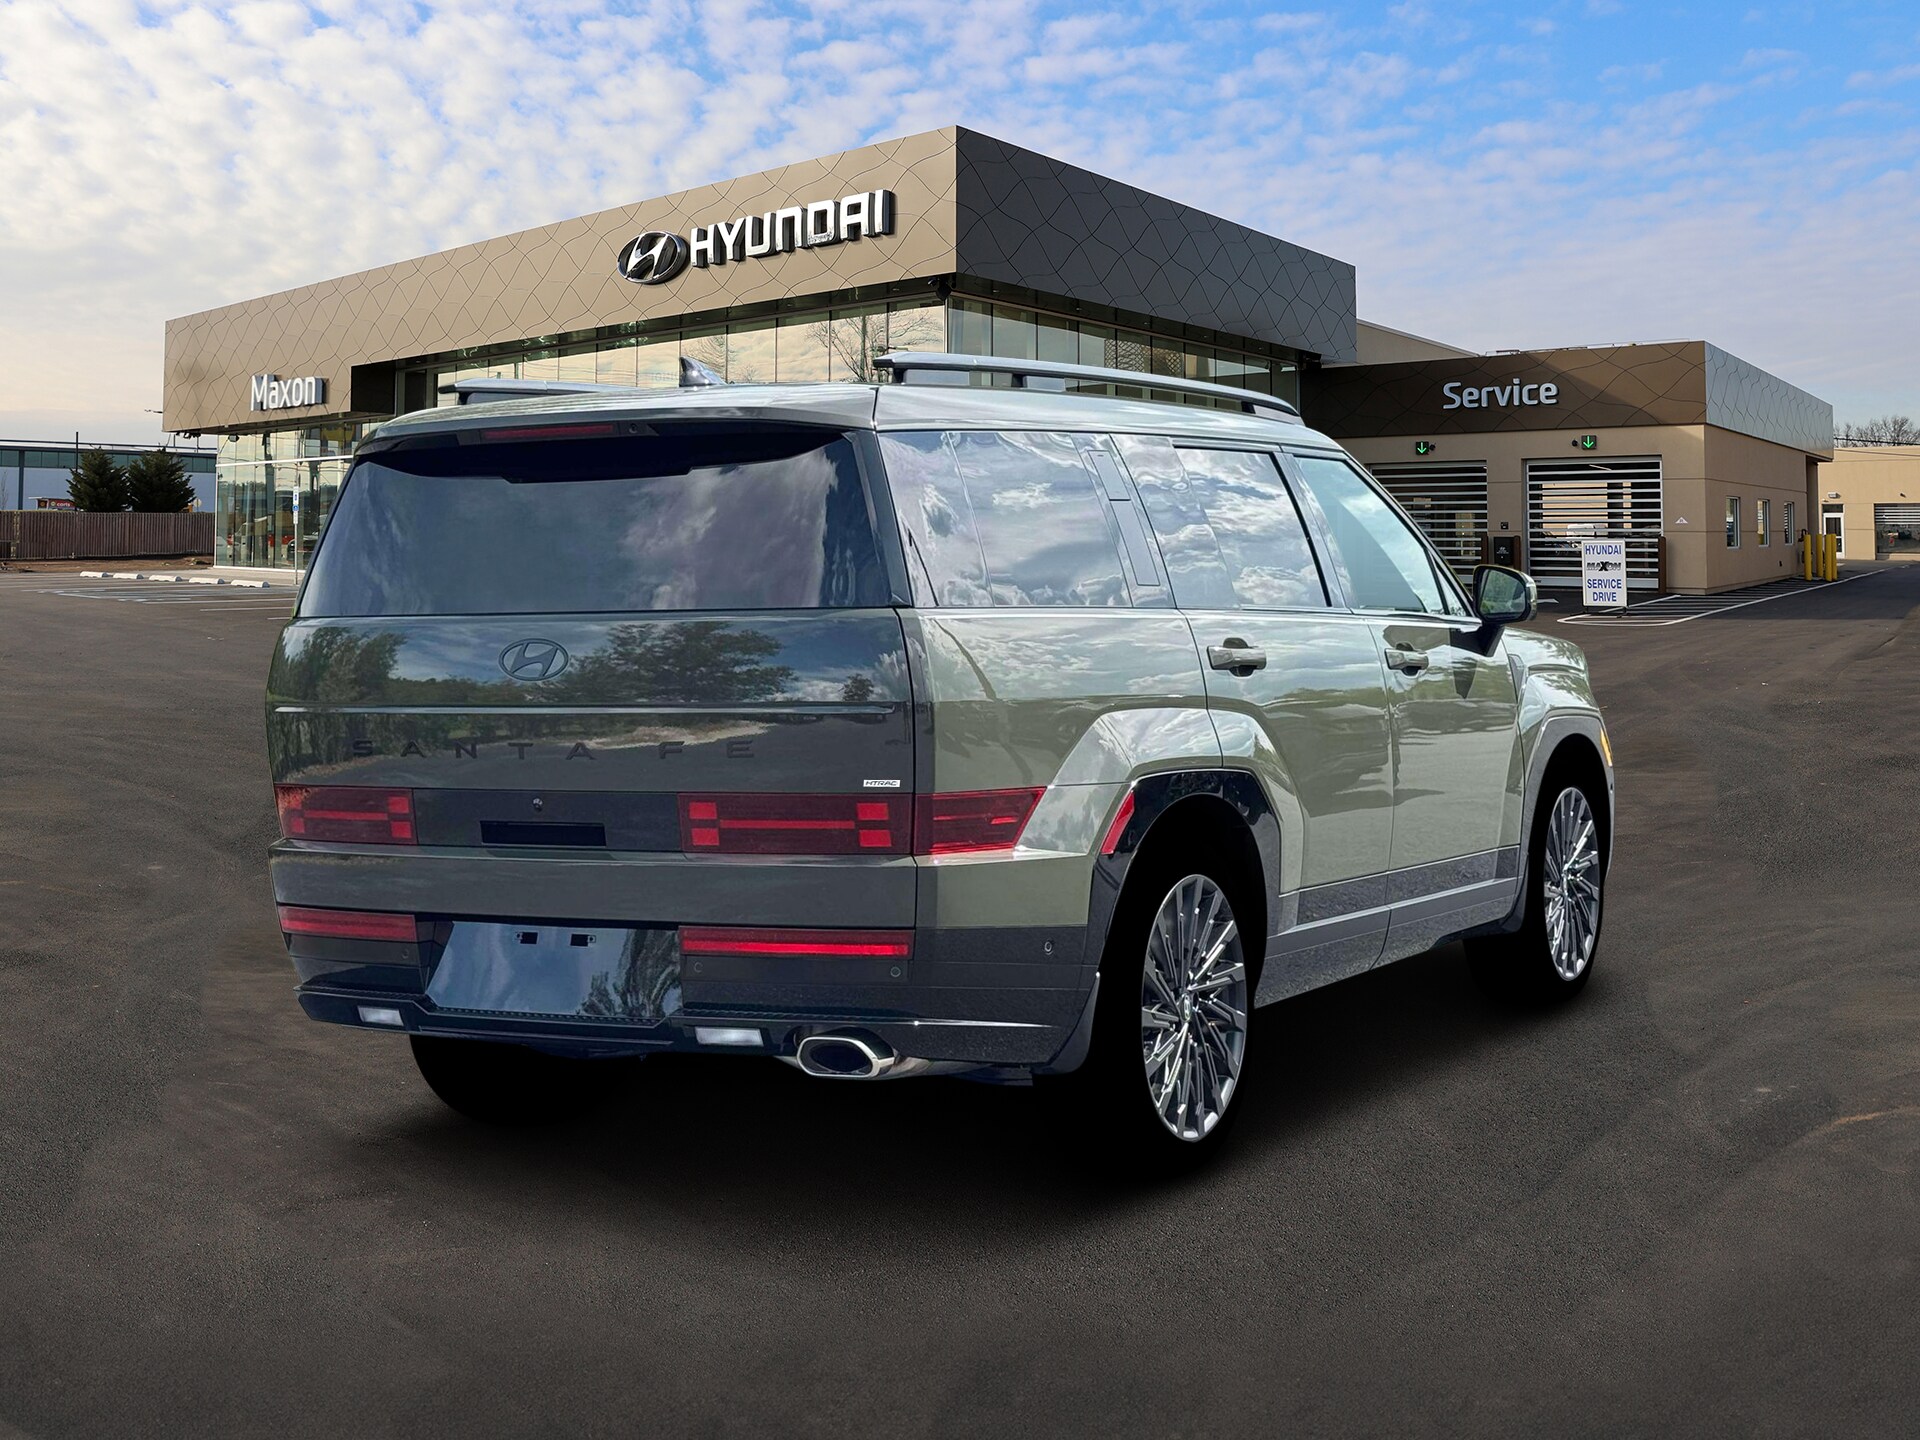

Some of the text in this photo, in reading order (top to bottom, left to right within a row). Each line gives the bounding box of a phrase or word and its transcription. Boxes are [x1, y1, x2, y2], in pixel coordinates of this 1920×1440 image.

[690, 189, 893, 267] HYUNDAI
[250, 374, 318, 411] Maxon
[1443, 378, 1558, 409] Service
[1585, 545, 1621, 555] HYUNDAI
[1586, 561, 1621, 571] MAXON
[1587, 579, 1622, 589] SERVICE
[1593, 592, 1617, 601] DRIVE
[353, 739, 754, 760] SANTA FE
